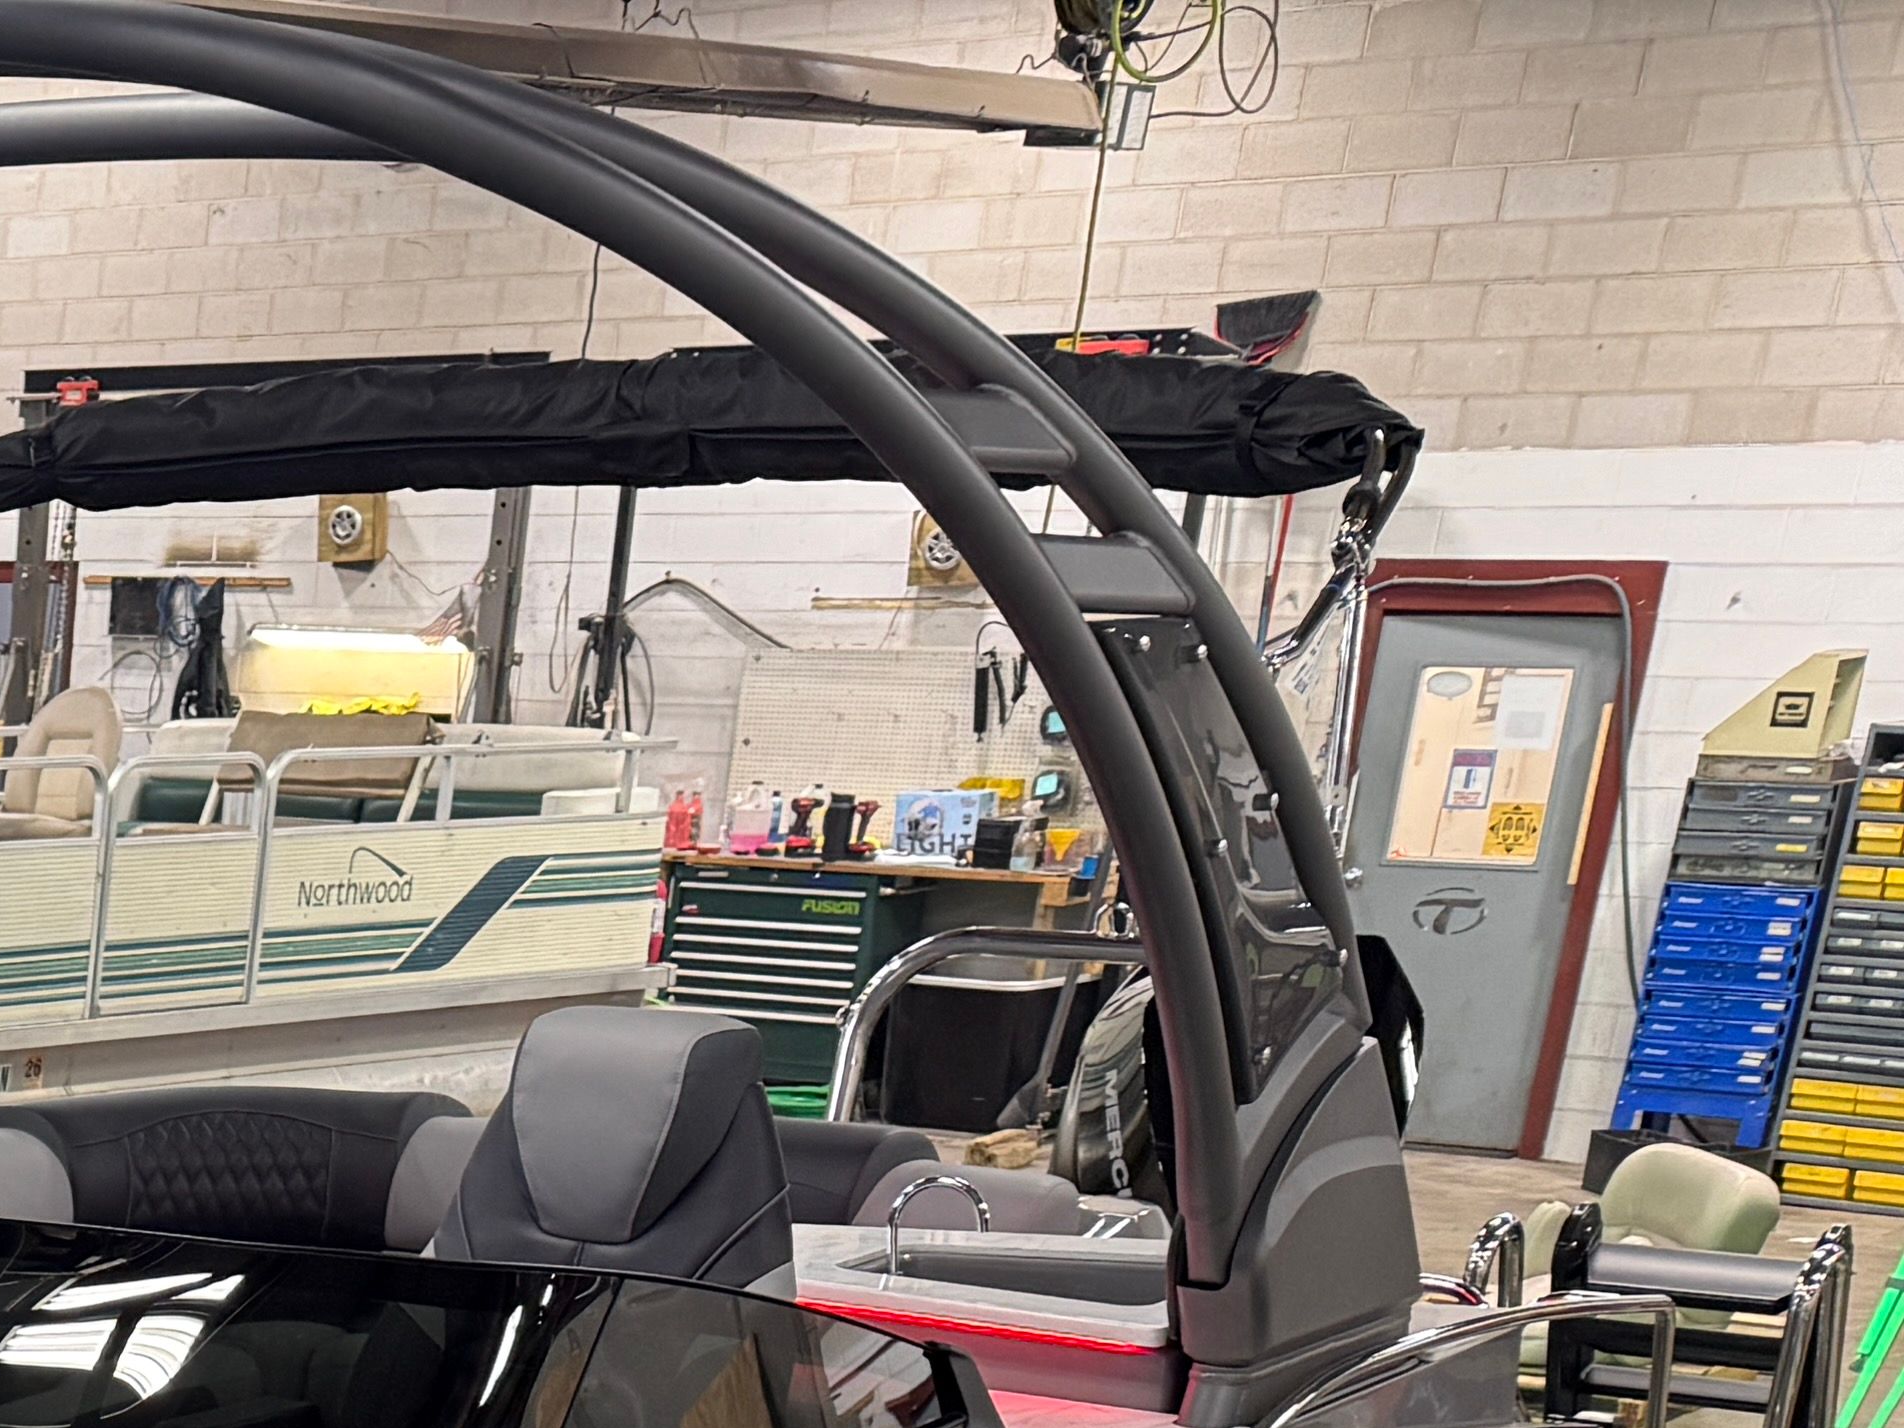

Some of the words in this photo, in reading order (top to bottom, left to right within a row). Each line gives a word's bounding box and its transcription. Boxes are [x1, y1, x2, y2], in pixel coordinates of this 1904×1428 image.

[297, 875, 414, 907] Northwood
[801, 899, 860, 916] FUSION
[24, 1058, 42, 1078] 26
